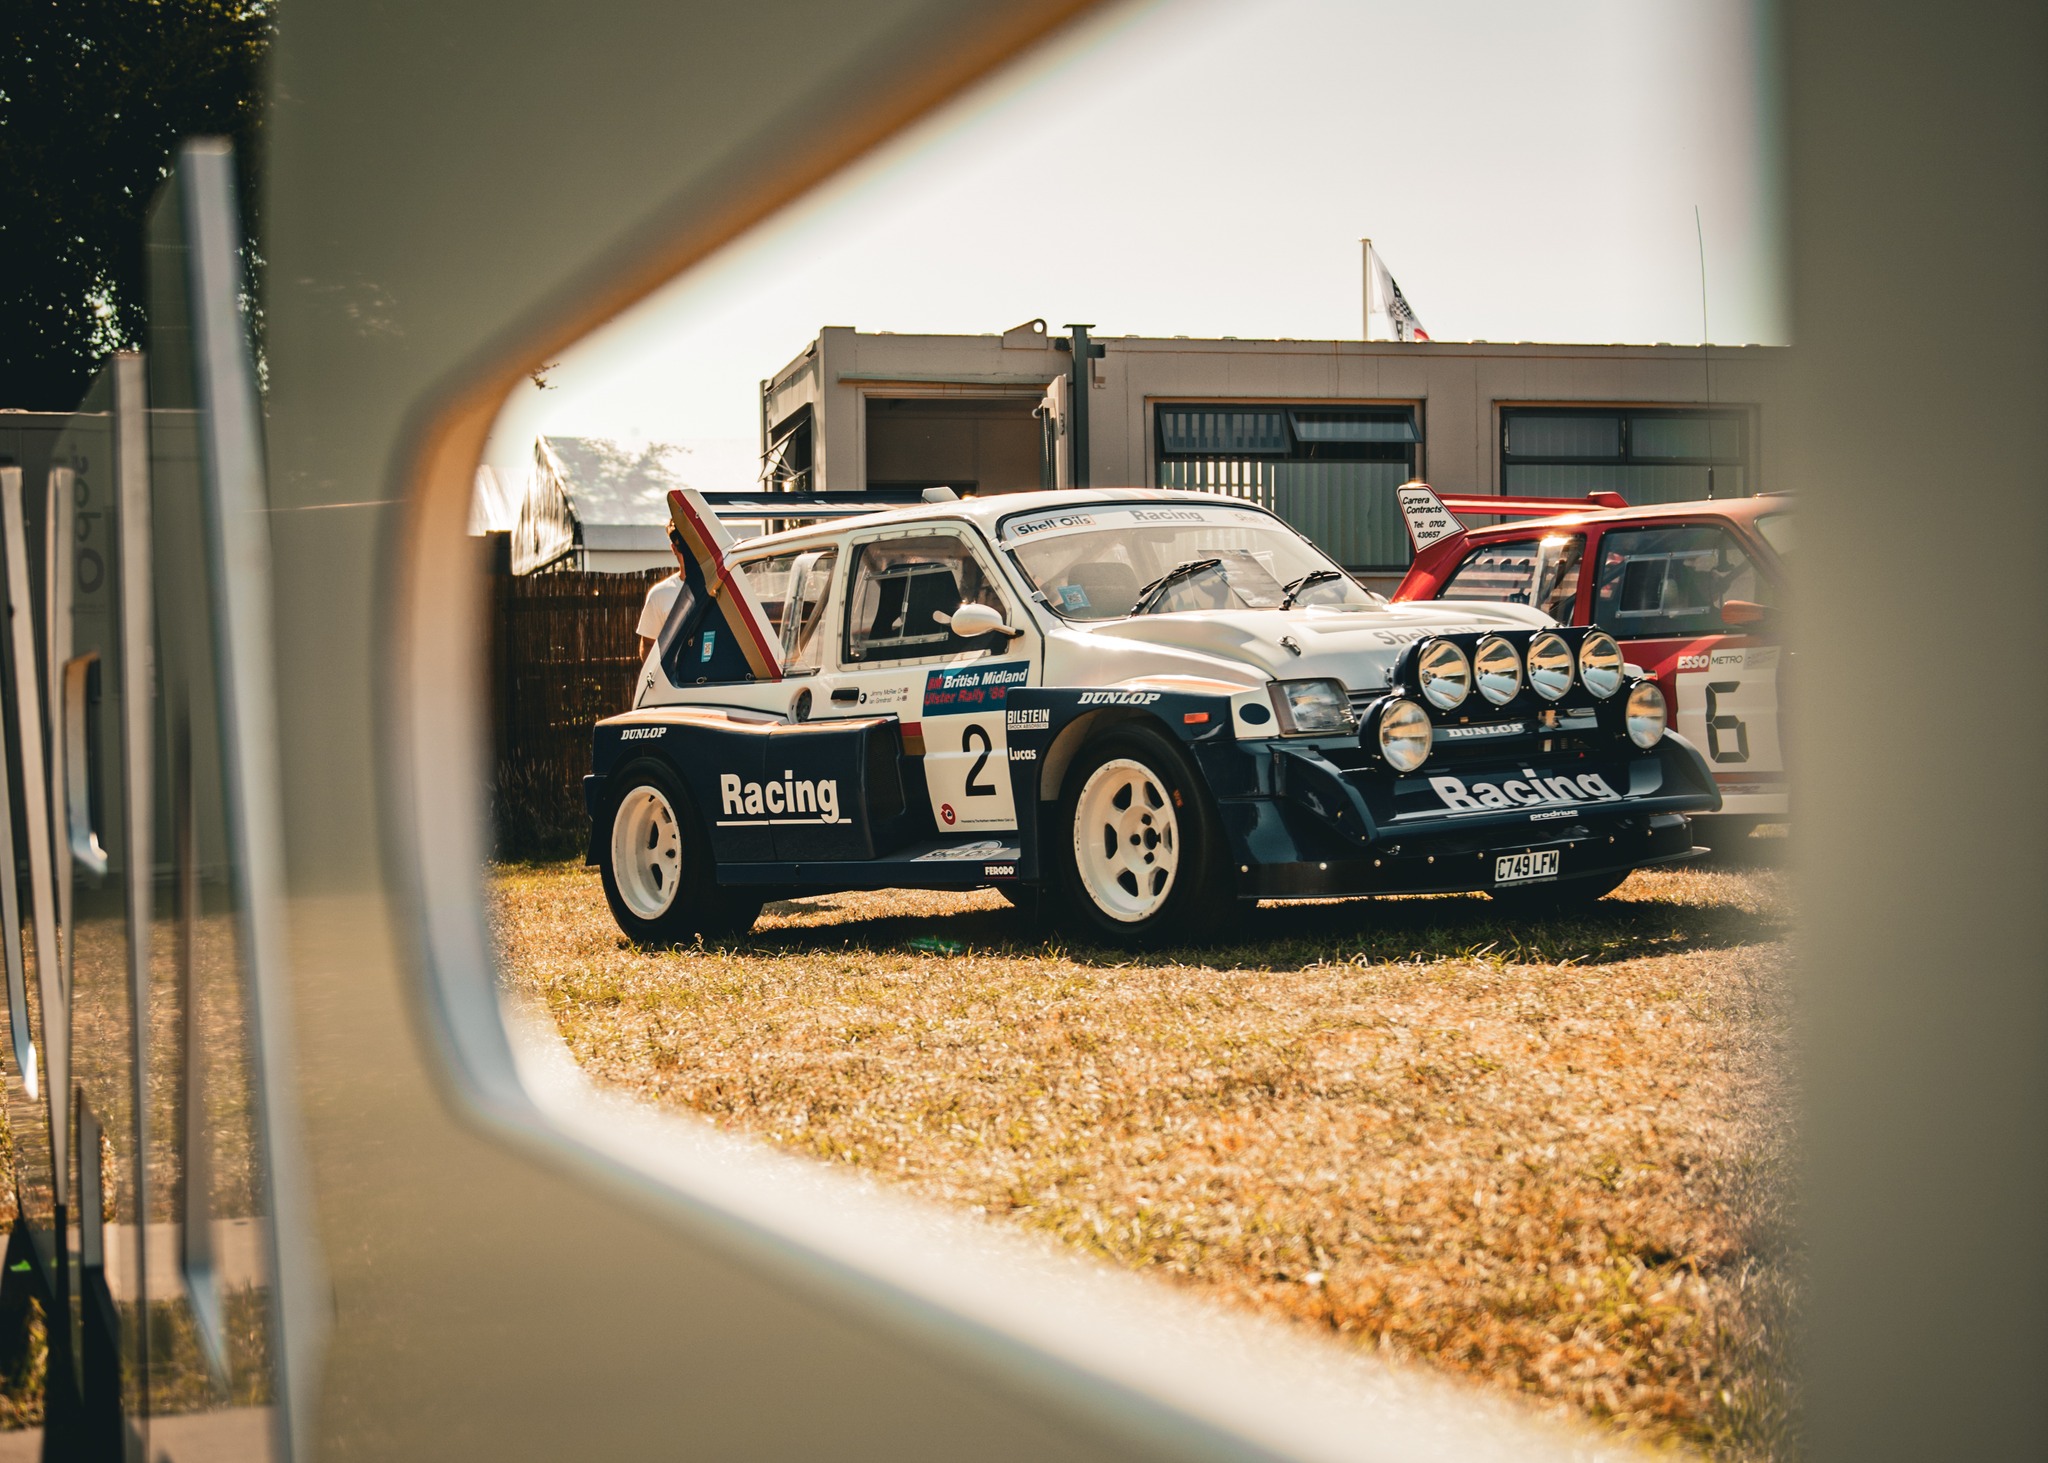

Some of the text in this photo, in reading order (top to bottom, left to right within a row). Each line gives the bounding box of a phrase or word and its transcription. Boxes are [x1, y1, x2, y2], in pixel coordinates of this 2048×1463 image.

[1402, 496, 1430, 505] Carrera
[1128, 508, 1205, 522] Racing
[1406, 505, 1442, 514] Contracts
[1017, 515, 1091, 536] Shell Oils
[1428, 520, 1446, 528] 0702
[1677, 655, 1710, 670] ESSO
[1711, 655, 1743, 665] METRO
[943, 673, 980, 689] British
[981, 668, 1028, 685] Midland
[924, 692, 957, 705] Ulster
[958, 688, 985, 703] Rally
[1077, 692, 1161, 705] DUNLOP
[1007, 708, 1050, 724] BILSTEIN
[1705, 680, 1750, 764] 6
[620, 727, 667, 741] DUNLOP
[1446, 723, 1525, 738] DUNLOP
[962, 724, 997, 797] 2
[1009, 747, 1037, 761] Lucas
[720, 769, 840, 824] Racing
[1428, 768, 1623, 810] Racing
[1530, 809, 1578, 821] prodrive
[984, 865, 1014, 876] FERODO
[1497, 852, 1558, 879] C749 LFM
